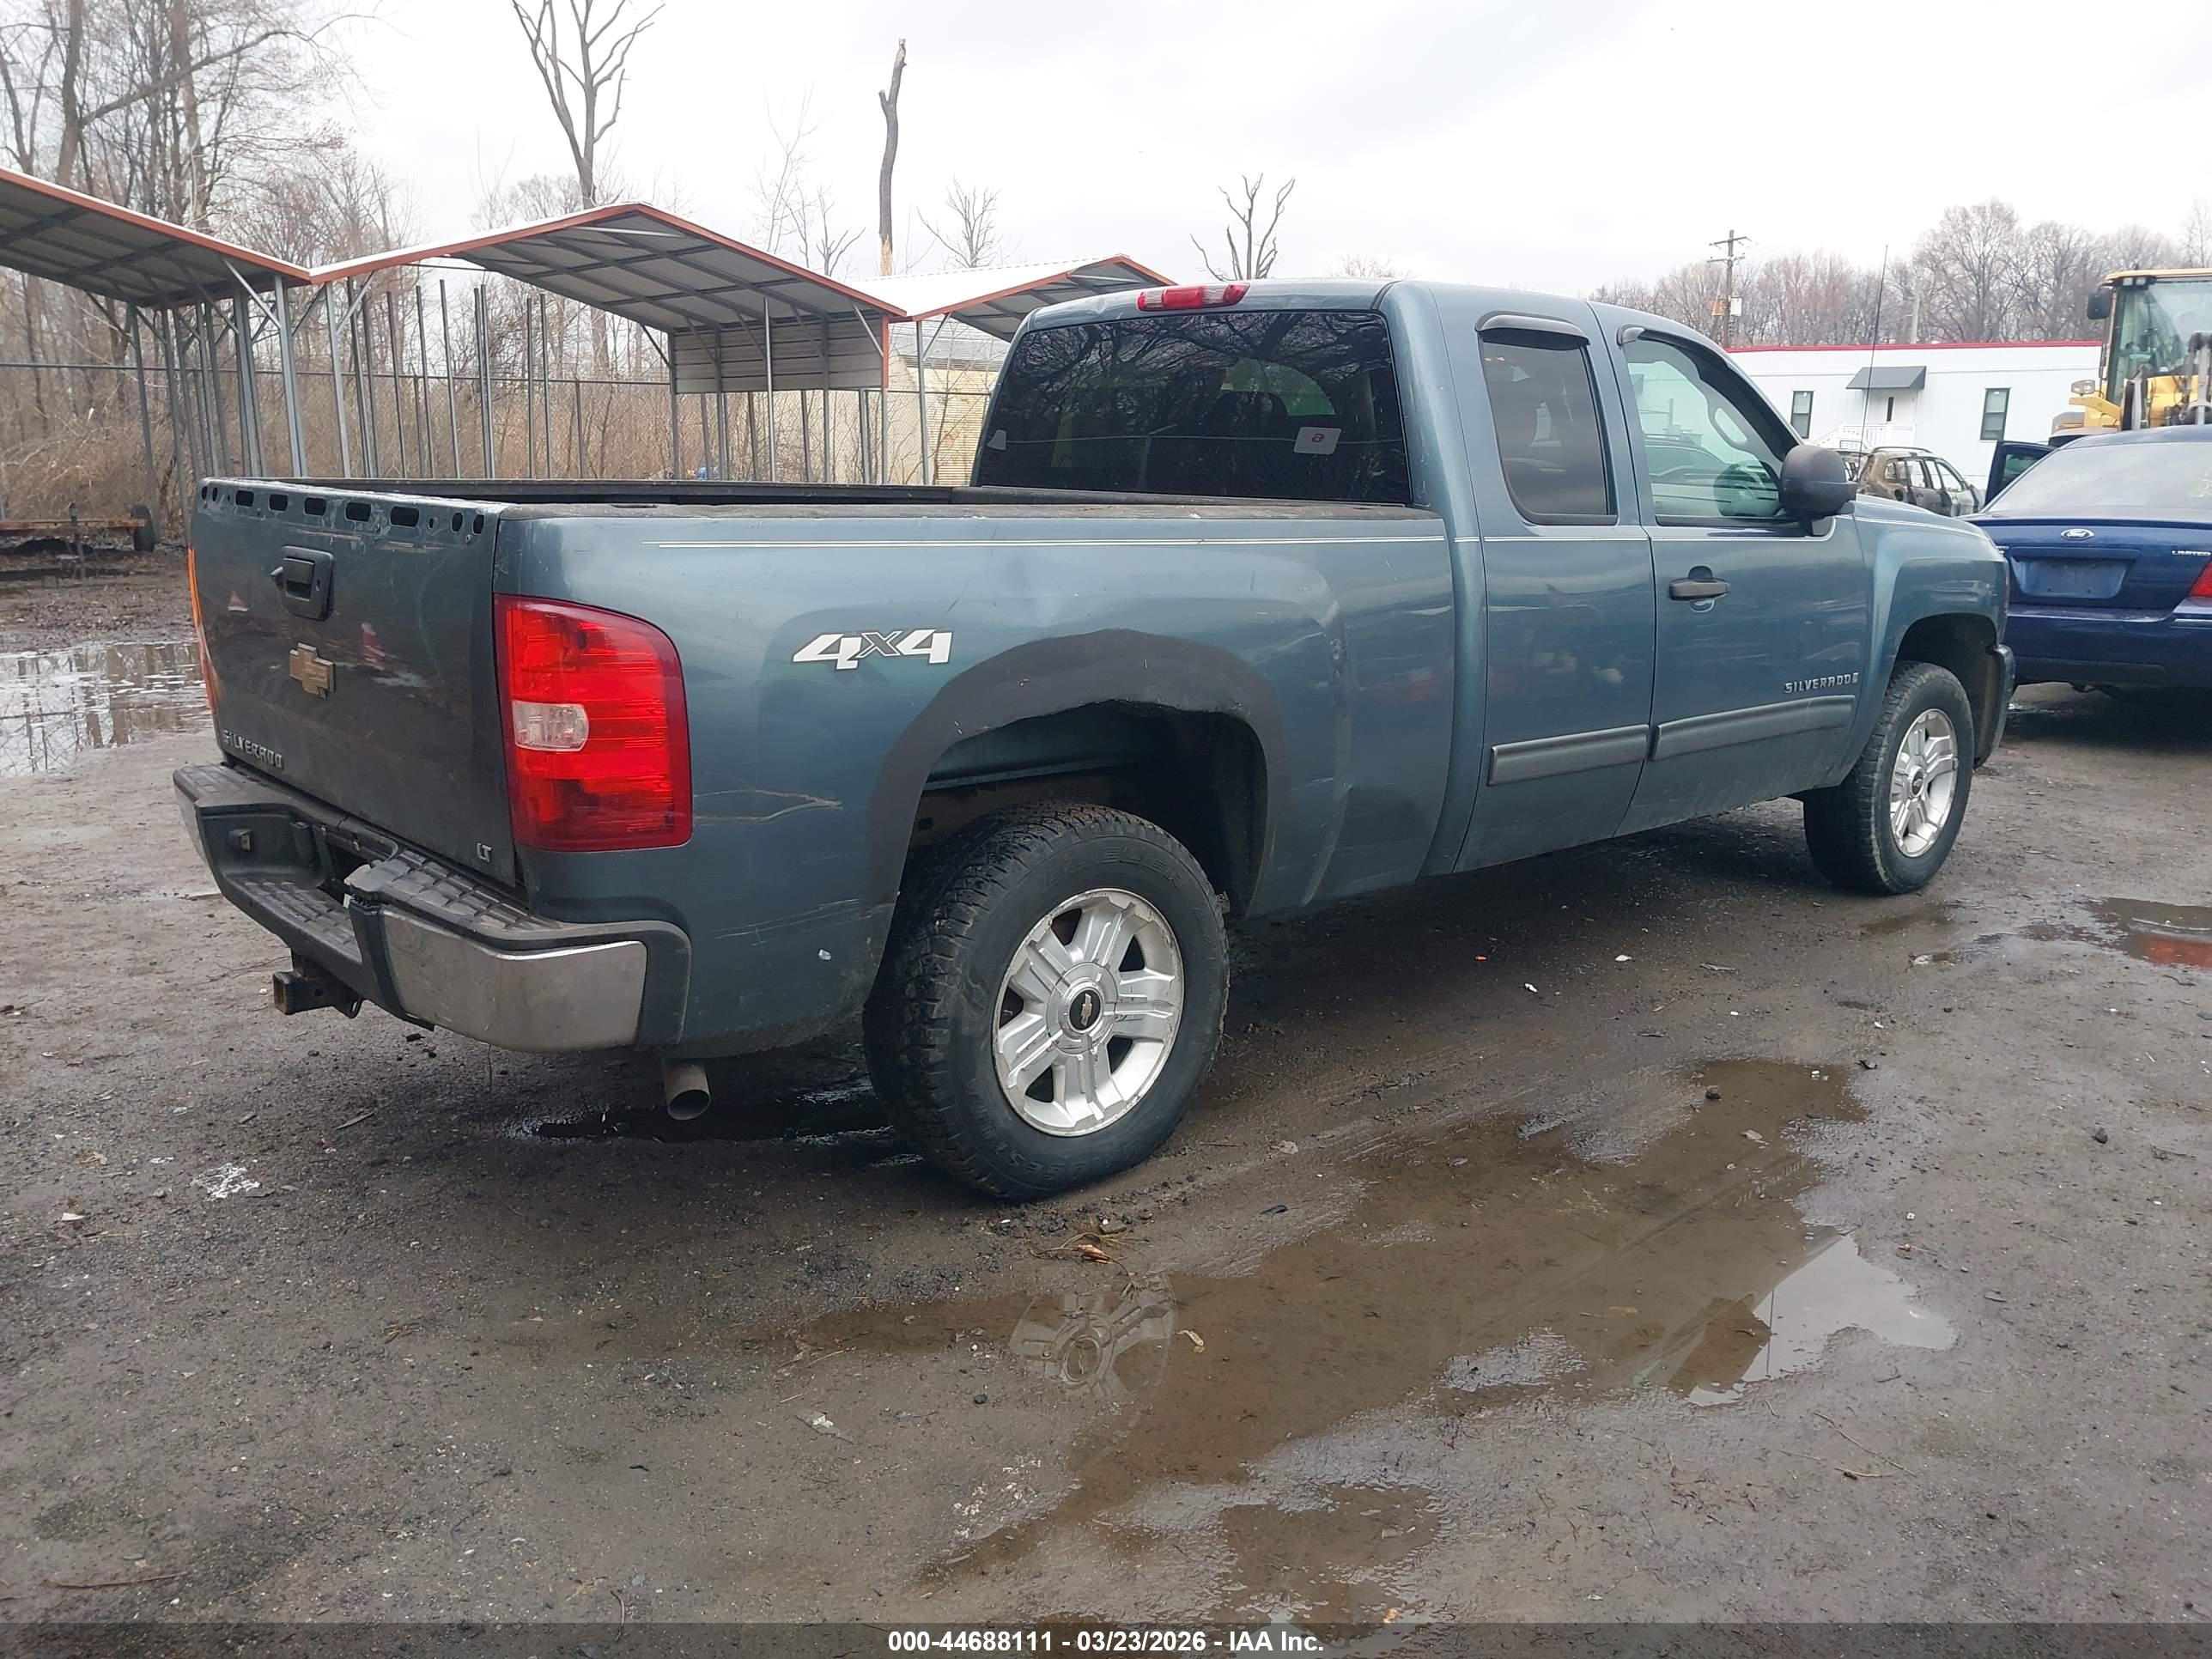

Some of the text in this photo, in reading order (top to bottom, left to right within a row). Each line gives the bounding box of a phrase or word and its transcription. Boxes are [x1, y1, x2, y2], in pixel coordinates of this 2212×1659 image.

[1784, 673, 1851, 694] SILVERADO
[222, 729, 283, 769] SILVERADO
[476, 842, 492, 862] LT
